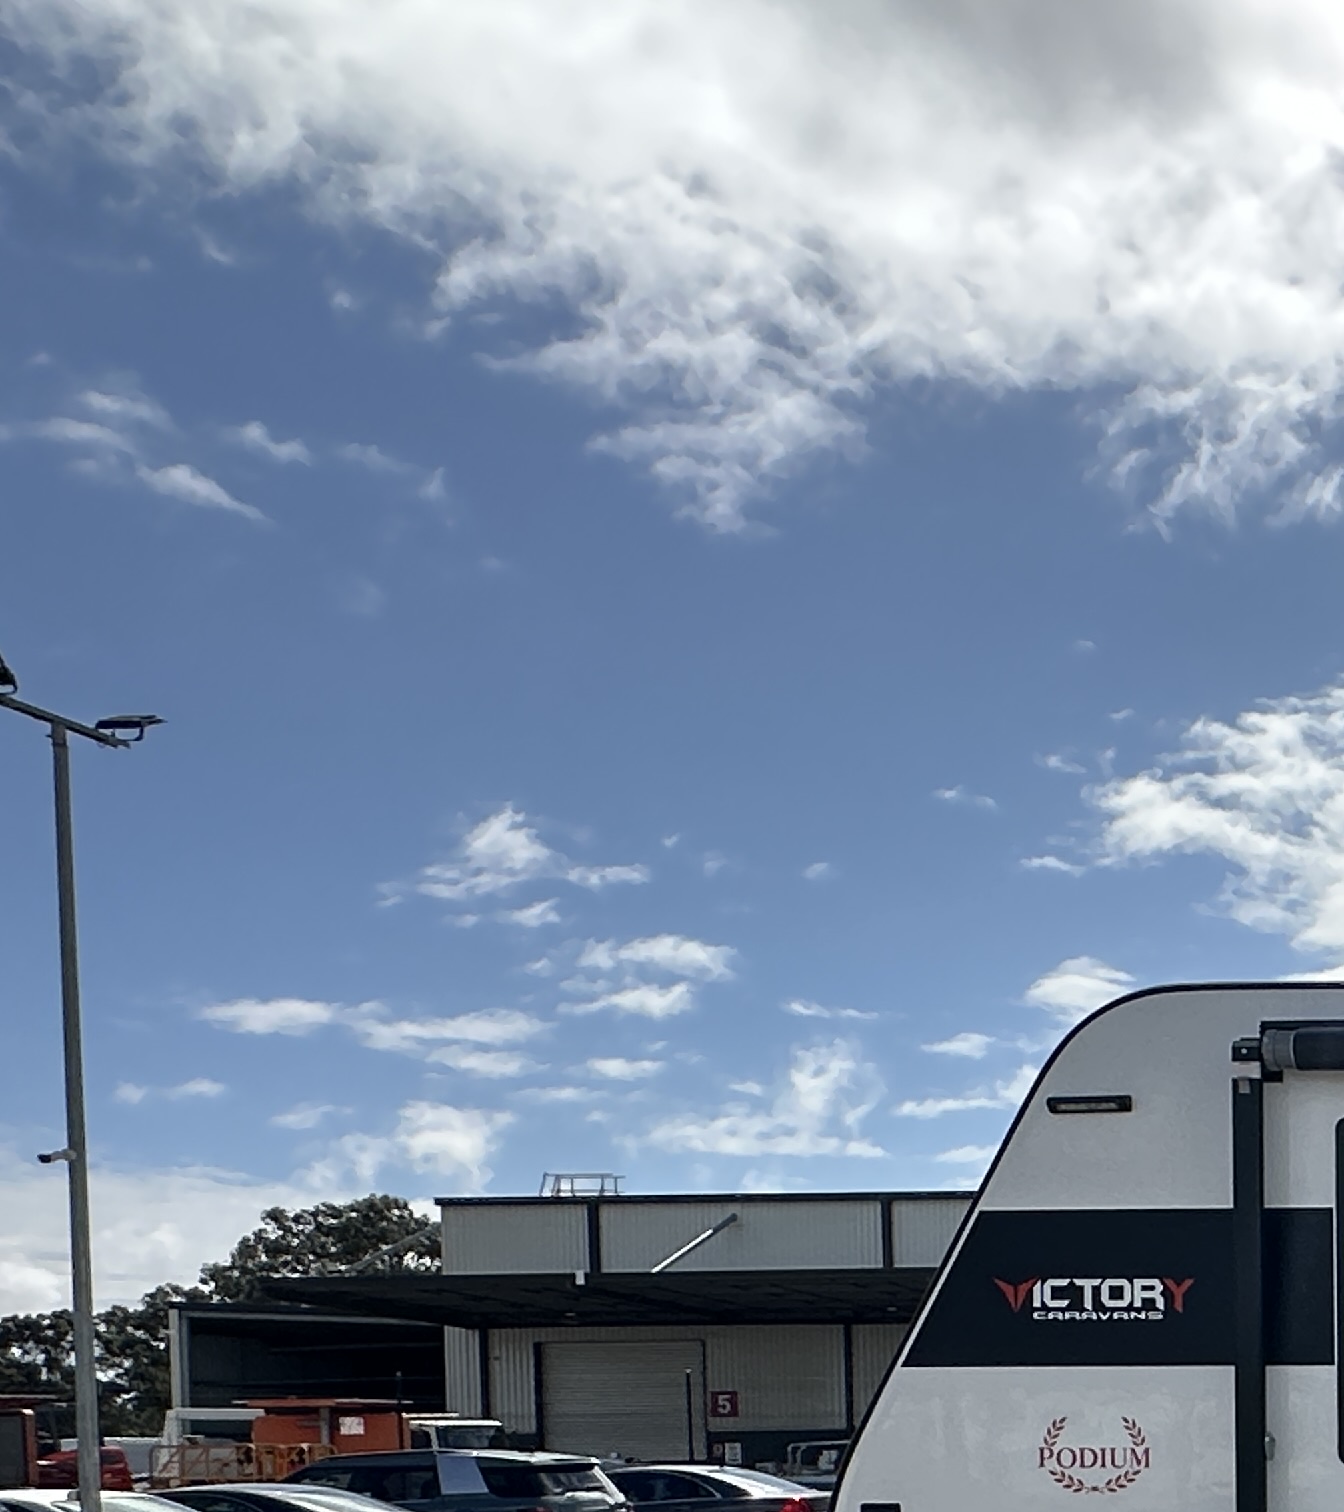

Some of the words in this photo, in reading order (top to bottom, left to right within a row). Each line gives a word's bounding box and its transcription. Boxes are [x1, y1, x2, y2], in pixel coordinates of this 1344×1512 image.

[992, 1276, 1195, 1313] VICTORY
[1032, 1310, 1164, 1320] CARAVANS
[717, 1394, 732, 1414] 5
[1038, 1446, 1151, 1469] PODIUM
